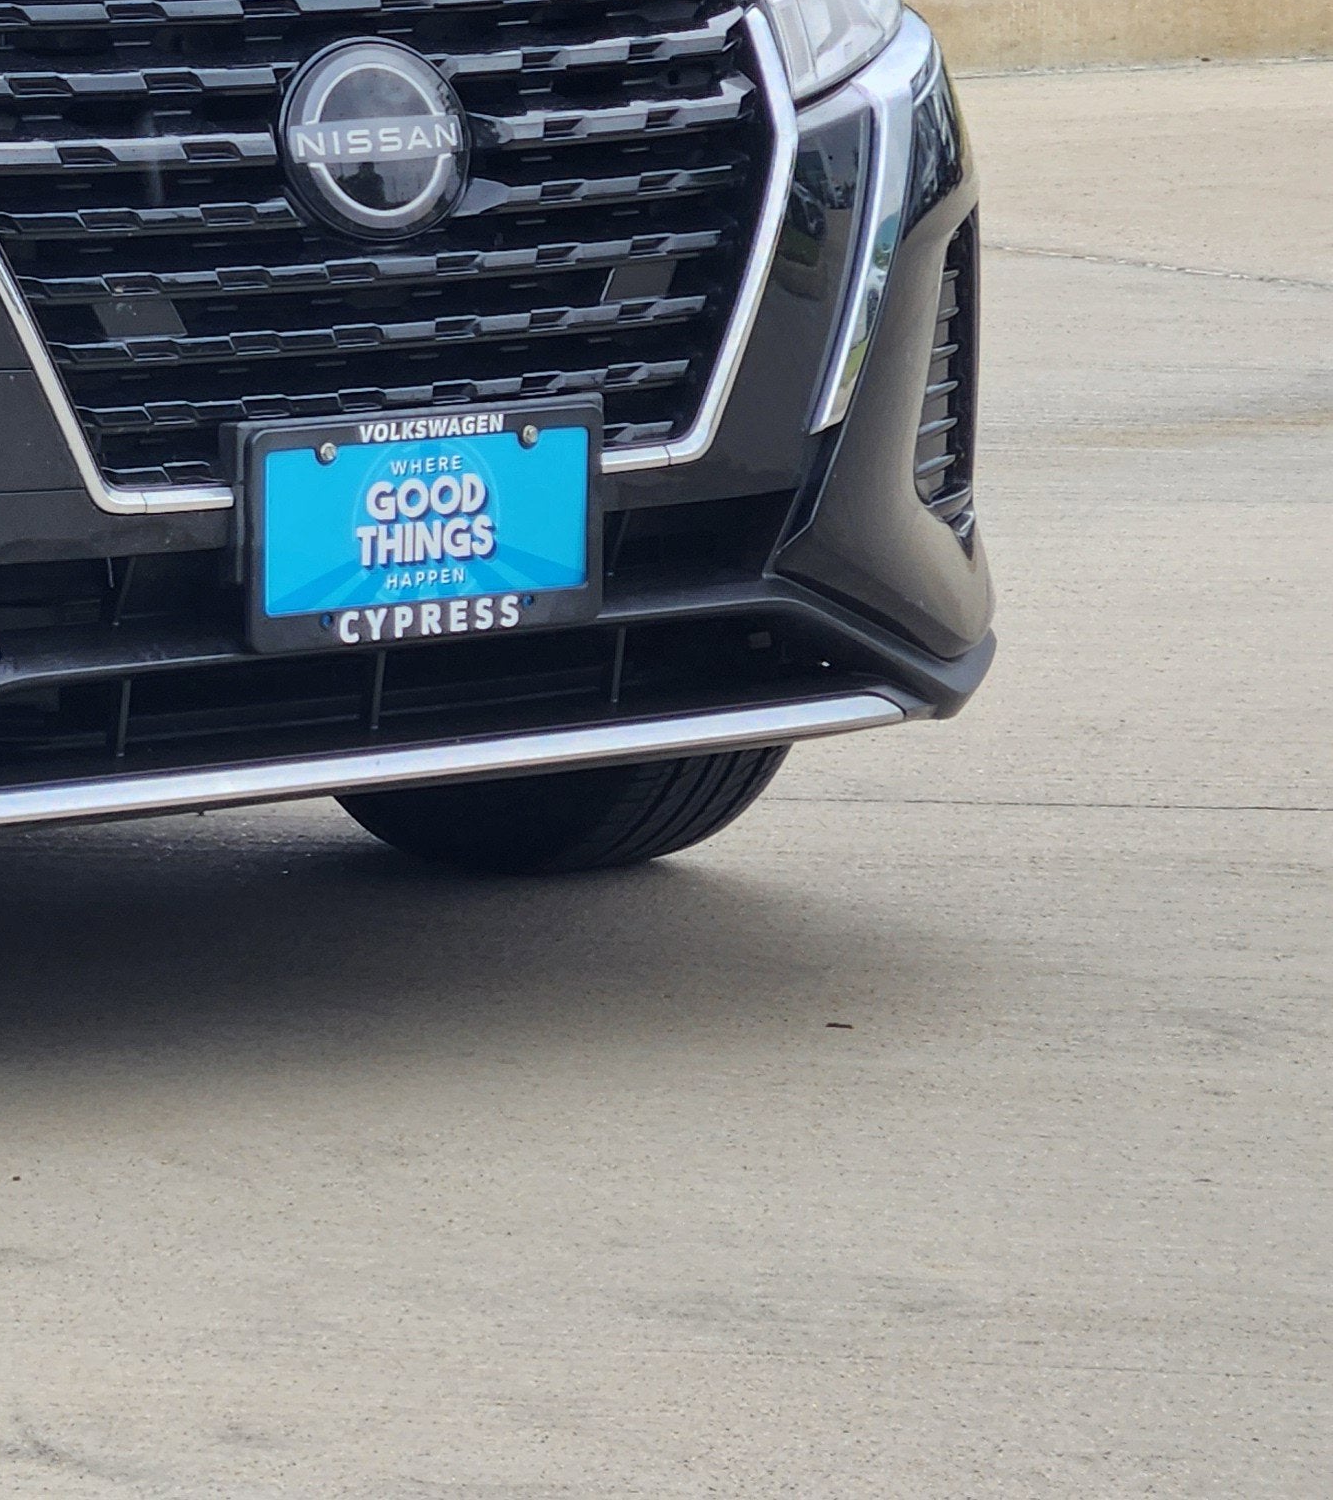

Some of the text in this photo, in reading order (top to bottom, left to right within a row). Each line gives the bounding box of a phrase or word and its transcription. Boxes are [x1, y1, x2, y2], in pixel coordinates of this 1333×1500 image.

[297, 123, 458, 157] NISSAN
[359, 414, 505, 443] VOLKSWAGEN
[390, 456, 463, 476] WHERE
[366, 473, 488, 521] GOOD
[356, 514, 496, 568] THINGS
[386, 567, 466, 591] HAPPEN
[339, 595, 521, 644] CYPRESS
